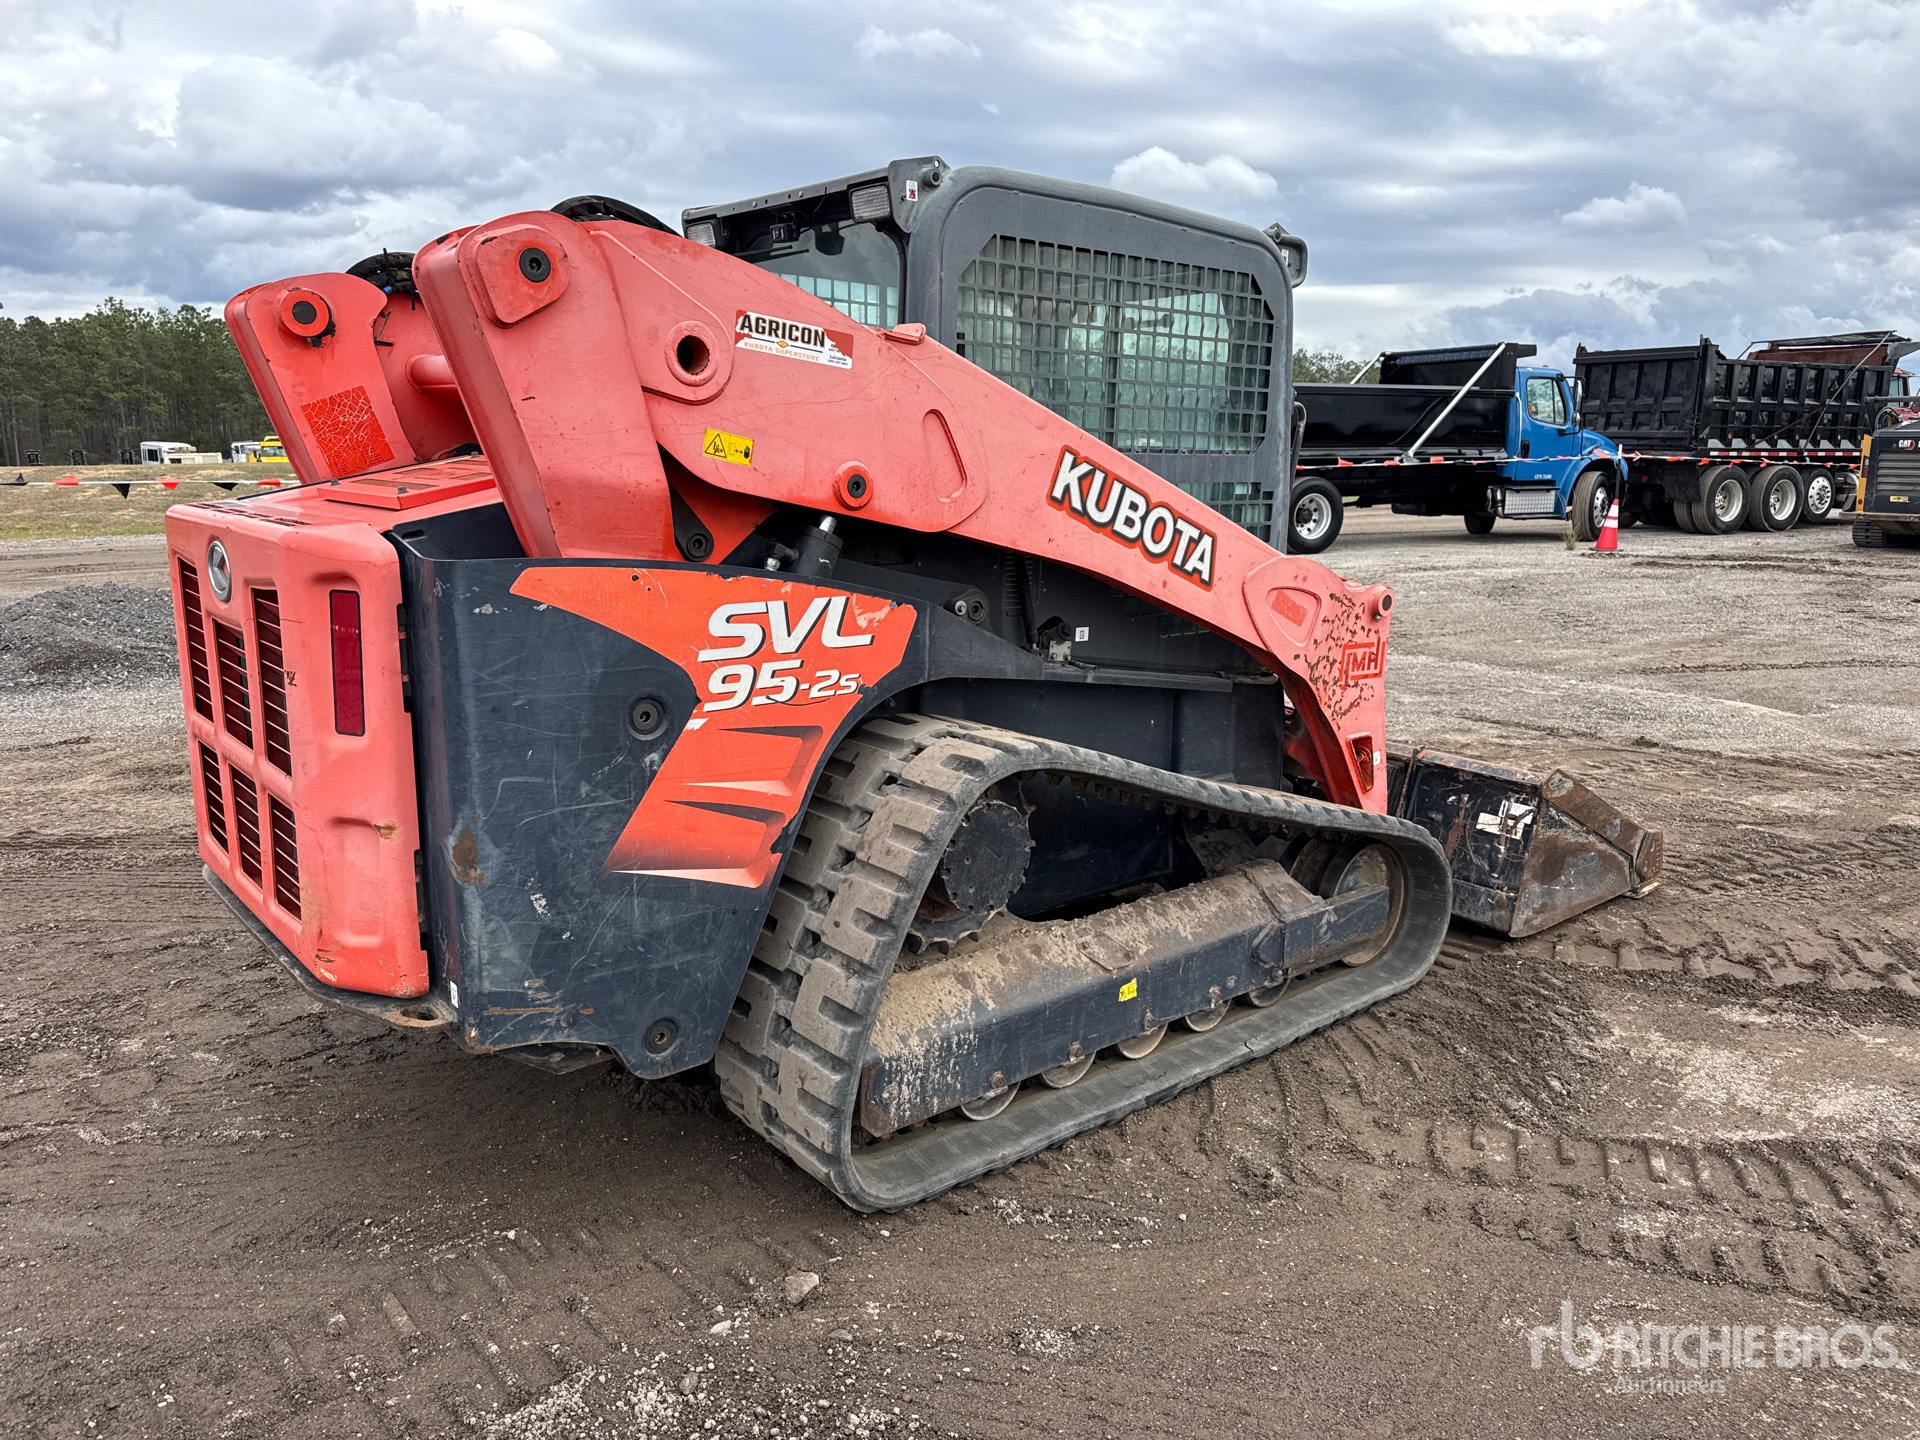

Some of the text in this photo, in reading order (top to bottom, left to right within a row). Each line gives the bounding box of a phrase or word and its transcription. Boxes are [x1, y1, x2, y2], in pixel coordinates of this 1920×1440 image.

[740, 314, 825, 348] AGRICON
[744, 341, 773, 353] KUBOTA
[775, 347, 820, 362] SUPERSTORE
[1898, 439, 1912, 448] CAT
[1051, 450, 1214, 584] KUBOTA
[697, 595, 874, 662] SVL
